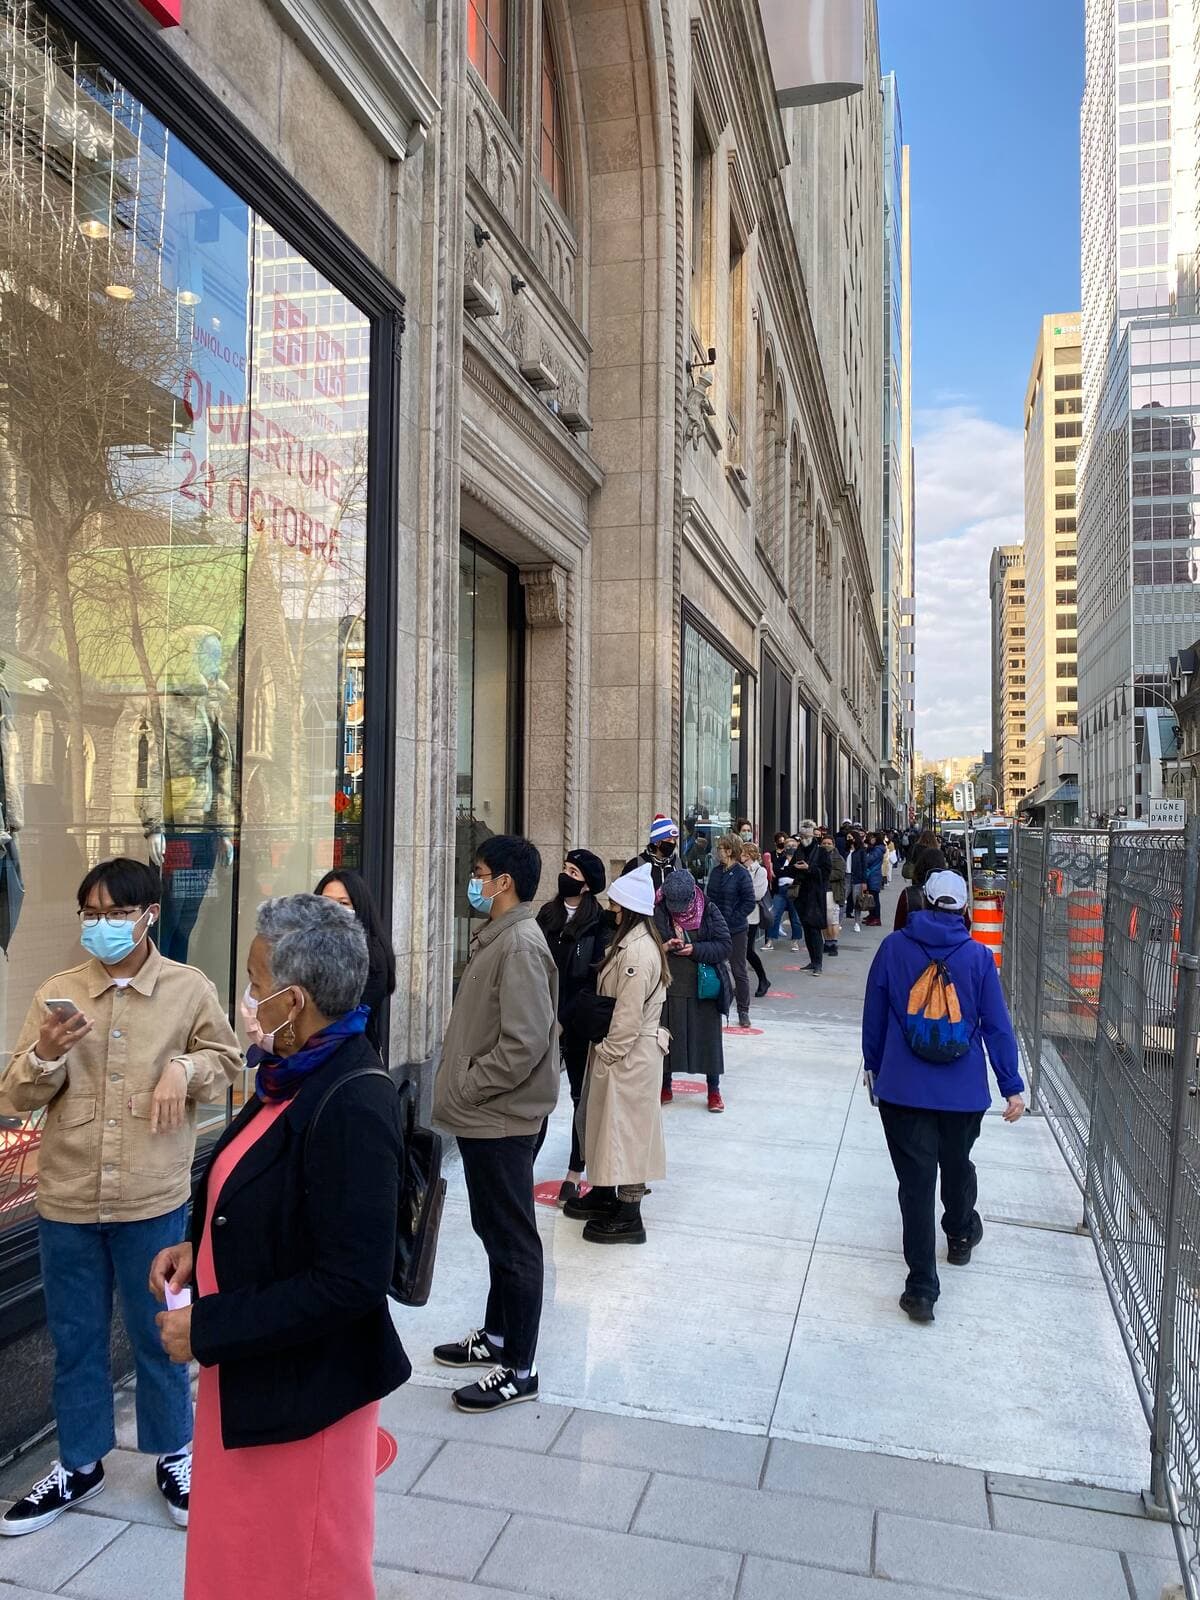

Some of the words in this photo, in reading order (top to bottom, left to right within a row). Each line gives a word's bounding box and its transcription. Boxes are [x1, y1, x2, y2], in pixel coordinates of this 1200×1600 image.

[193, 326, 231, 364] UNIQLO
[182, 369, 342, 504] OUVERTURE
[179, 450, 215, 510] 23
[227, 477, 342, 570] OCTOBRE
[1155, 802, 1180, 811] LIGNE
[472, 1344, 491, 1360] N
[499, 1382, 518, 1400] N
